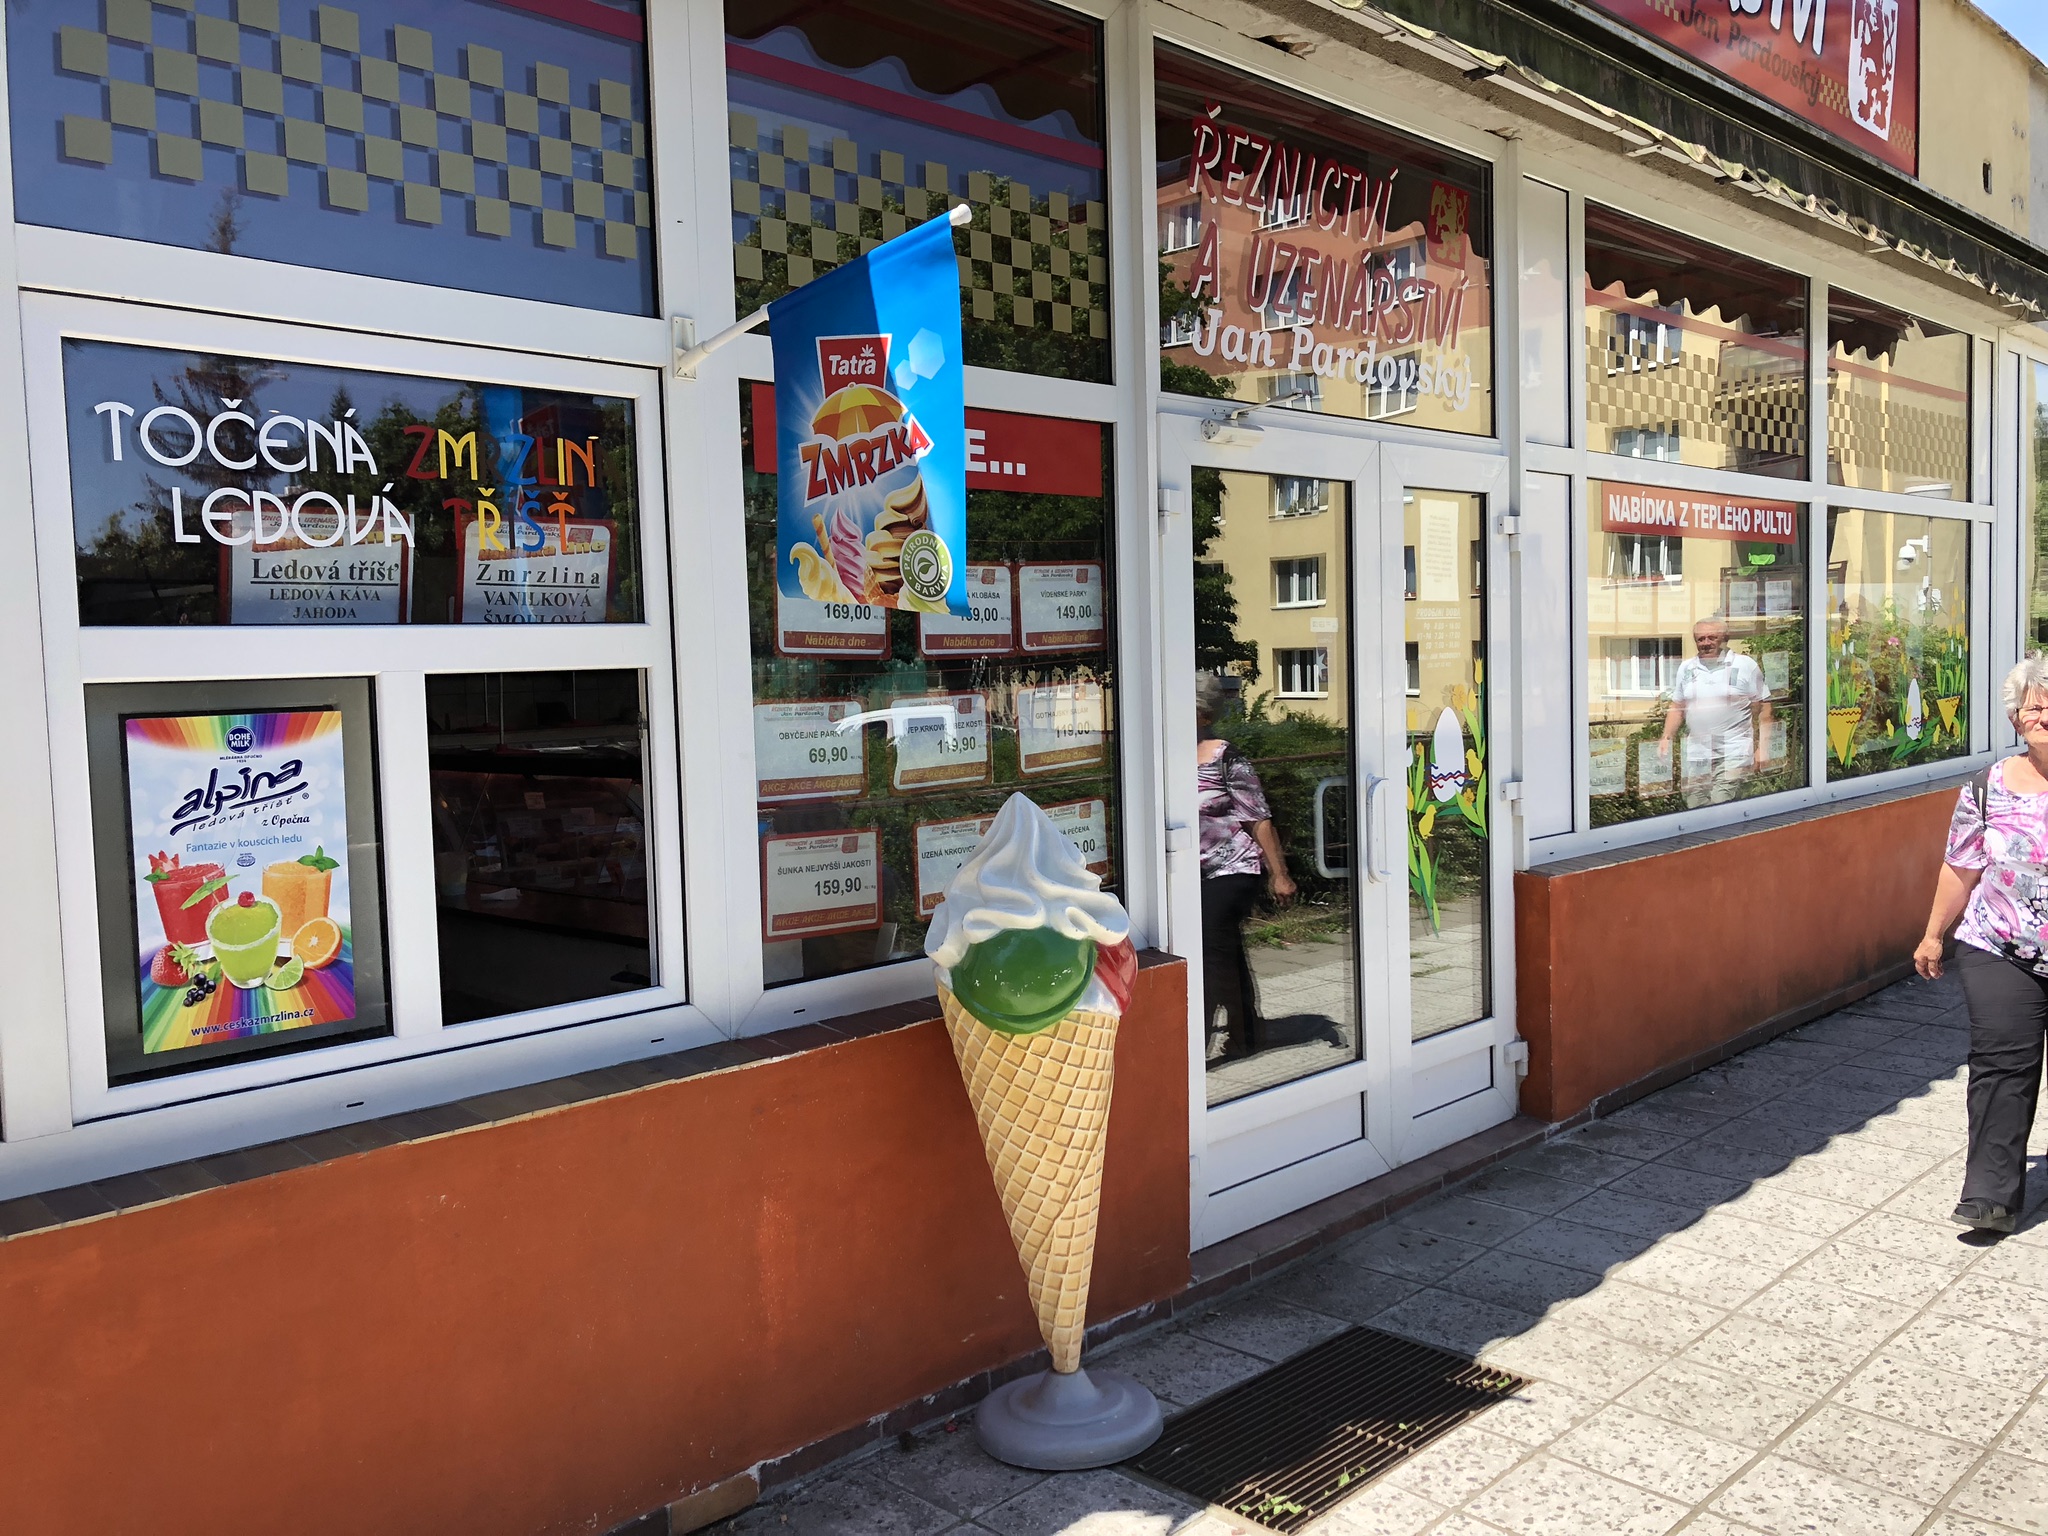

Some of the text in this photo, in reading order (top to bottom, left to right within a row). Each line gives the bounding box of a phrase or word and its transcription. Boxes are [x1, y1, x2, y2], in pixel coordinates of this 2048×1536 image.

[1680, 0, 1719, 43] Jan
[1187, 97, 1399, 247] ŘEZNICTVÍ
[1190, 218, 1470, 354] A UZENÁŘSTVÍ
[828, 354, 877, 376] Tatra
[1192, 308, 1471, 411] Jan Pardovský
[94, 398, 378, 476] TOČENÁ
[799, 418, 931, 501] ZMRZKA
[172, 482, 415, 548] LEDOVÁ
[1608, 491, 1792, 535] NABÍDKA Z TEPLÉHO PULTU
[251, 558, 399, 581] Ledová tříšť
[476, 563, 600, 585] Zmrzlina
[914, 564, 949, 596] BARVIVA
[269, 586, 381, 601] LEDOVÁ KÁVA
[484, 589, 592, 608] VANILKOVÁ
[971, 590, 1001, 599] KLOBÁSA
[293, 606, 357, 619] JAHODA
[823, 603, 872, 622] 169,00
[1056, 605, 1091, 621] 149,00
[804, 635, 845, 647] Nabídka
[943, 636, 977, 647] Nabídka
[229, 733, 251, 741] BOHE
[231, 740, 250, 748] MILK
[778, 730, 819, 740] OBYČEJNÉ
[808, 746, 848, 765] 69,90
[172, 759, 304, 820] alpina
[761, 783, 786, 793] AKCE
[787, 781, 812, 791] AKCE
[192, 808, 245, 831] ledová
[272, 814, 310, 829] Opočna
[186, 841, 228, 853] Fantazie
[281, 833, 302, 844] ledu
[921, 848, 943, 859] UZENÁ
[777, 859, 872, 876] ŠUNKA NEJVYŠŠÍ JAKOSTI
[814, 877, 862, 896] 159,90
[190, 1007, 314, 1037] www.ceskazmrzlina.cz
